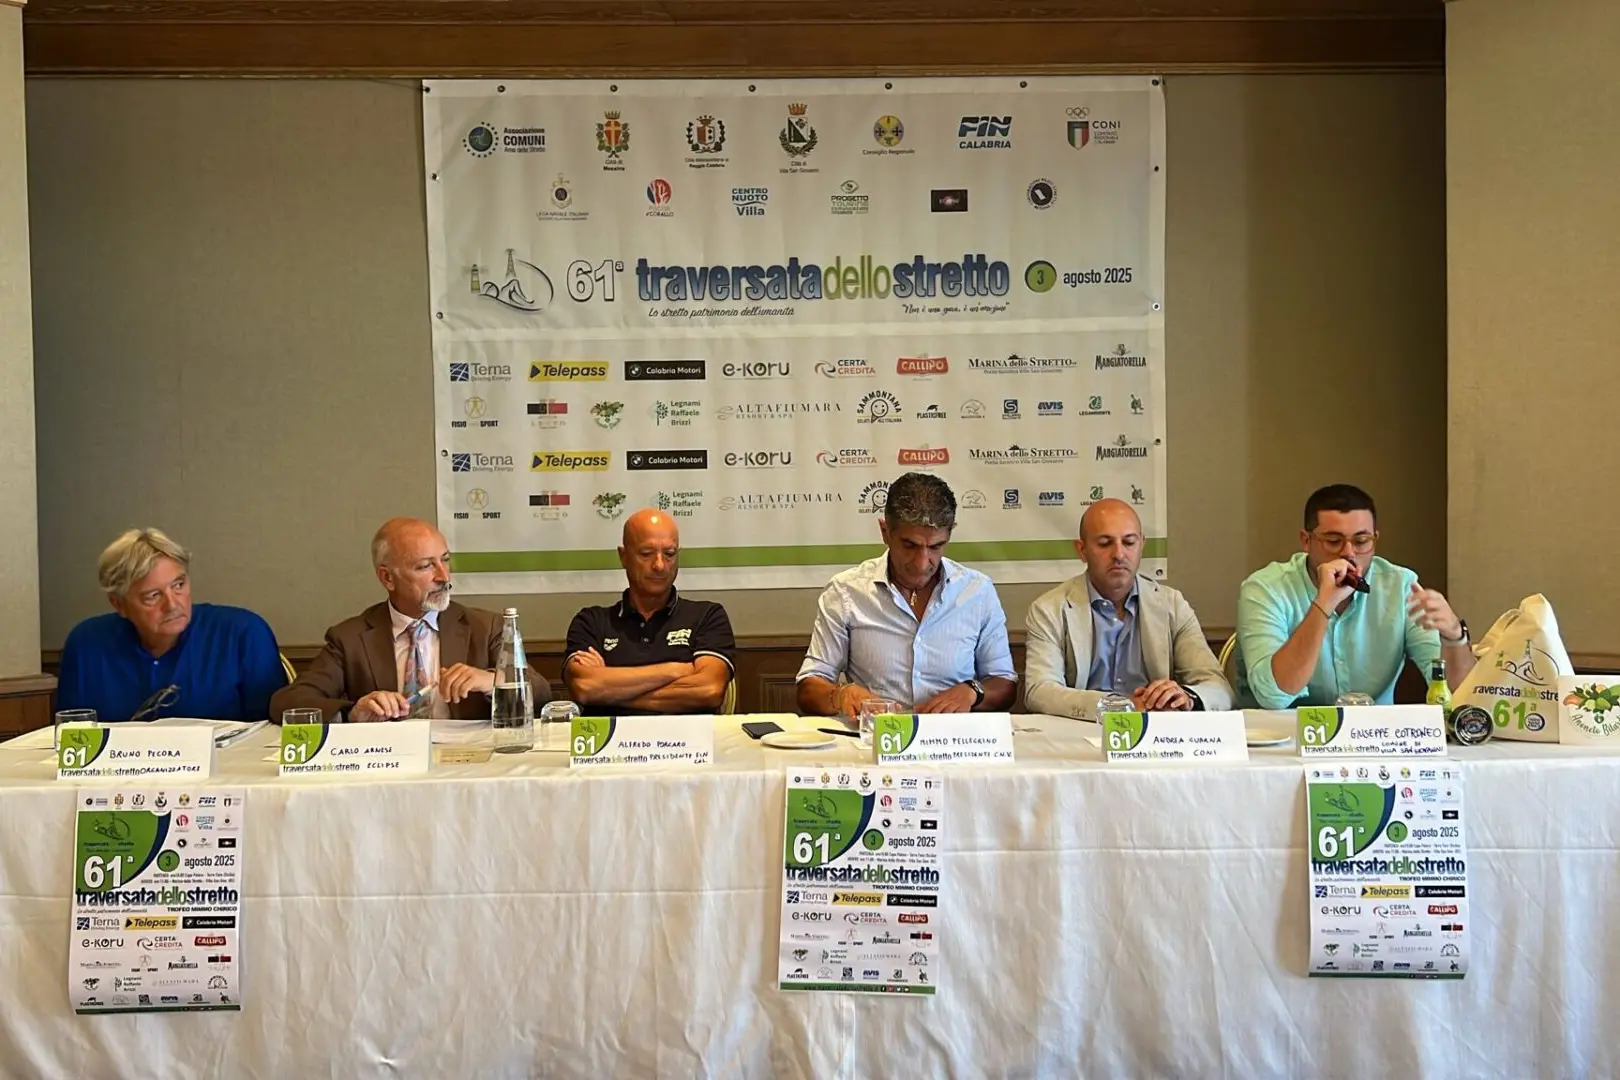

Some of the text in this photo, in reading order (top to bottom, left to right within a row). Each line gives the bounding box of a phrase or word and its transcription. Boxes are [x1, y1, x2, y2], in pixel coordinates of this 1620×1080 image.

[958, 116, 1012, 138] FIN
[1092, 120, 1121, 129] CONI
[504, 136, 546, 147] COMUNI
[959, 140, 1012, 149] CALABRIA
[732, 187, 768, 195] CENTRO
[736, 206, 765, 217] Villa
[1036, 267, 1132, 287] 3 agosto 2025
[661, 307, 689, 317] stretto
[689, 307, 739, 319] patrimonio
[901, 360, 945, 371] CALLIPO
[1009, 358, 1028, 367] dello
[471, 362, 511, 376] Terna
[543, 363, 606, 380] Telepass
[646, 366, 676, 375] Calabria
[676, 366, 701, 374] Motori
[837, 367, 876, 375] CREDITA
[670, 400, 701, 408] Legnami
[856, 389, 903, 415] SAMMONTANA
[1038, 401, 1064, 410] AVIS
[670, 409, 701, 417] Raffaele
[736, 402, 841, 414] ALTAFIUMARA
[480, 420, 498, 428] SPORT
[671, 418, 692, 427] Brizzi
[839, 448, 869, 457] CERTA
[902, 451, 945, 461] CALLIPO
[1009, 449, 1029, 458] dello
[472, 453, 514, 466] Terna
[544, 453, 608, 470] Telepass
[648, 456, 678, 465] Calabria
[679, 455, 703, 464] Motori
[839, 457, 878, 465] CREDITA
[672, 490, 703, 499] Legnami
[738, 493, 843, 505] ALTAFIUMARA
[1039, 491, 1065, 501] AVIS
[482, 511, 501, 519] SPORT
[673, 509, 693, 517] Brizzi
[1350, 727, 1389, 740] GIUSEPPE
[618, 740, 686, 749] ALFREDO PORCARO
[920, 737, 998, 746] MIMMO PELLEGRINO
[1153, 736, 1184, 746] ANDREA
[109, 748, 181, 760] BRUNO PECORA
[330, 746, 393, 757] CARLO ARNESE
[695, 751, 709, 759] FIN
[1193, 748, 1217, 758] CONI
[1400, 746, 1413, 754] SAN
[367, 761, 400, 770] ECLIPSE
[1412, 829, 1438, 841] agosto
[1439, 826, 1459, 839] 2025
[888, 837, 915, 849] agosto
[916, 835, 937, 848] 2025
[165, 854, 235, 870] 3 agosto 2025
[1311, 855, 1466, 876] traversatadellostretto
[785, 863, 941, 885] traversatadellostretto
[76, 886, 239, 907] traversatadellostretto
[1328, 885, 1357, 896] Terna
[1369, 886, 1410, 900] Telepass
[801, 891, 828, 901] Terna
[841, 893, 882, 905] Telepass
[860, 911, 882, 919] CERTA
[91, 917, 120, 927] Terna
[134, 917, 177, 930] Telepass
[154, 935, 177, 943] CERTA
[154, 941, 184, 949] CREDITA
